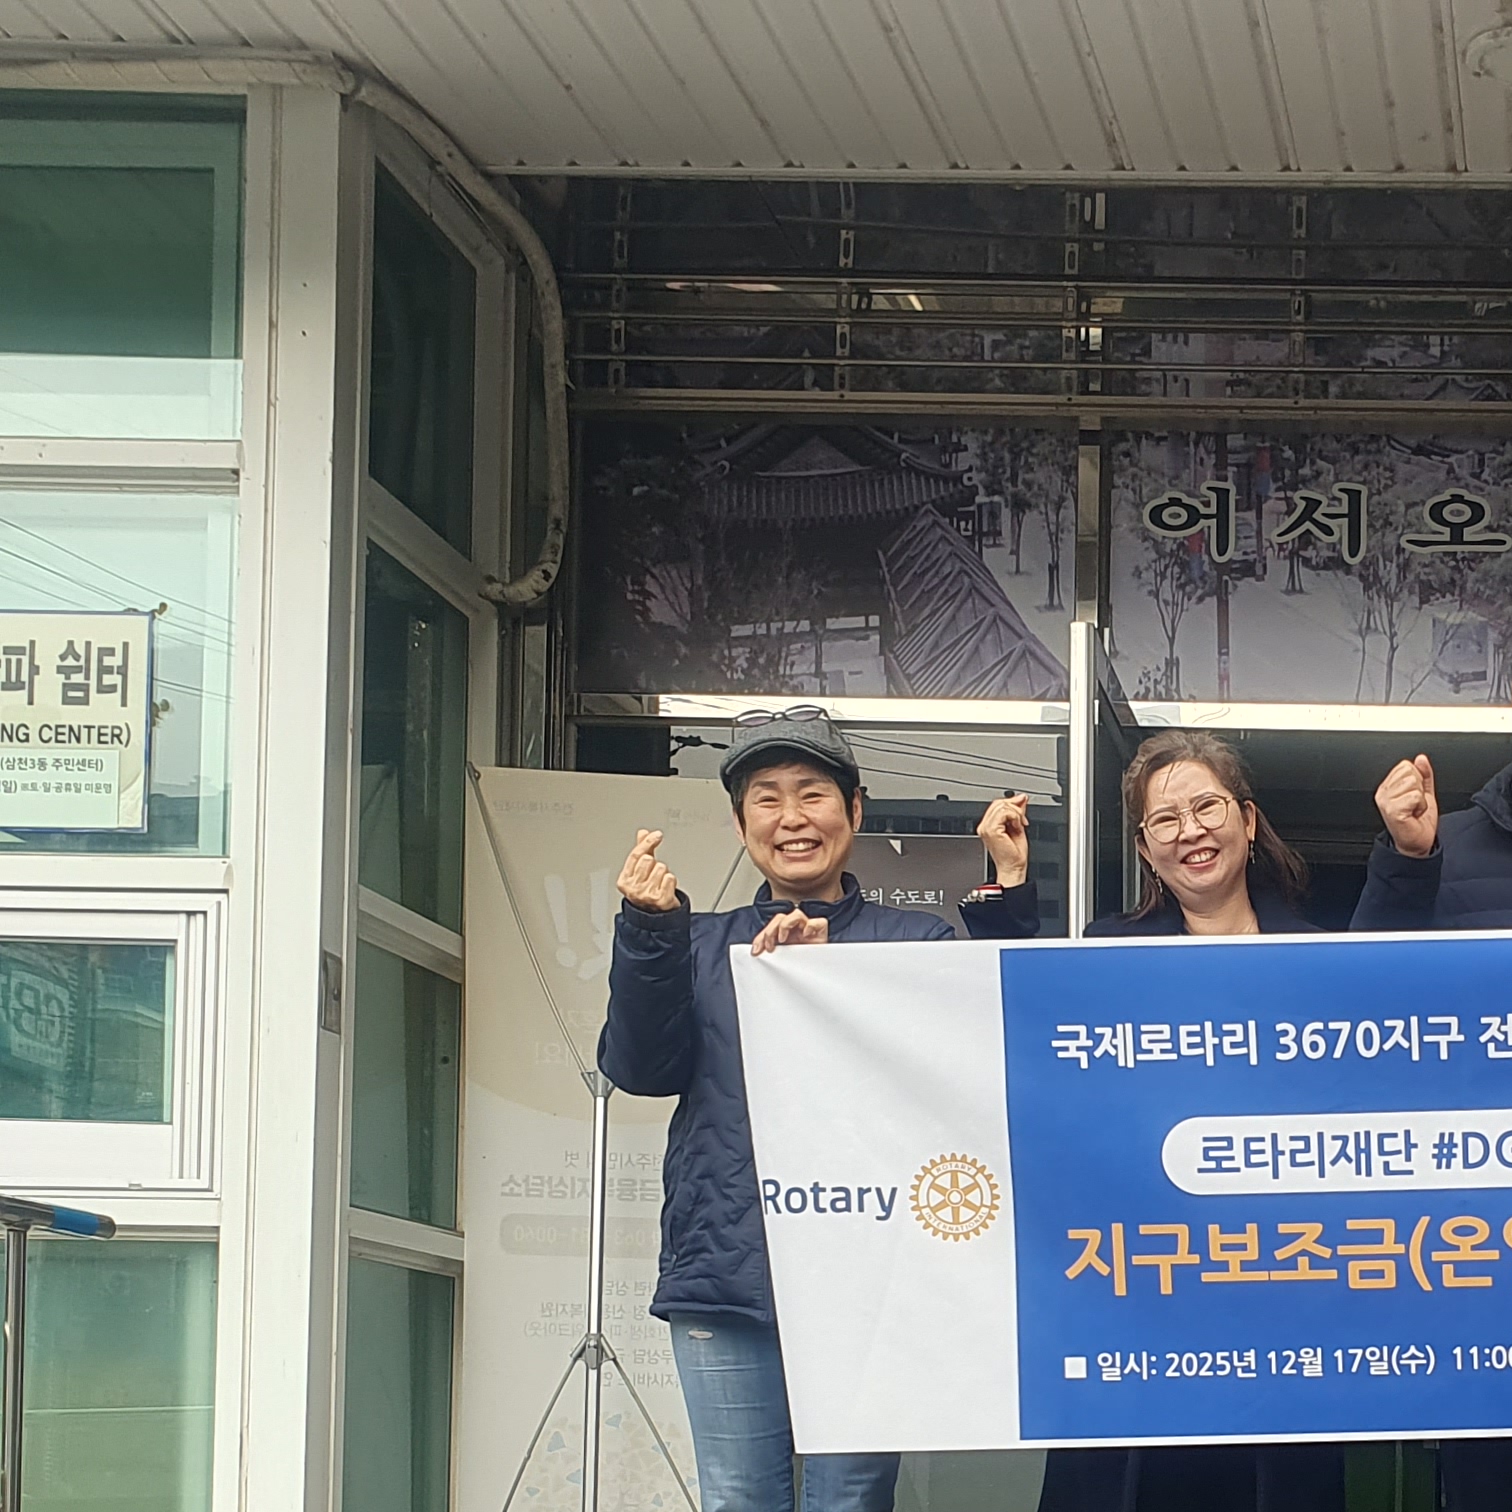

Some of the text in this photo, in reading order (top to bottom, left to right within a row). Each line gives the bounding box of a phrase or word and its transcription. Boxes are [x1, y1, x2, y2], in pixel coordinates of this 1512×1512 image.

[0, 639, 129, 708] 파 쉼터
[38, 722, 131, 748] CENTER)
[0, 756, 104, 773] (삼천3동 주민센터)
[0, 780, 18, 794] 일)
[84, 782, 112, 795] 미운영
[889, 888, 944, 906] 수도로!
[1051, 1019, 1258, 1069] 국제로타리
[1274, 1015, 1465, 1062] 3670지구
[1197, 1129, 1419, 1180] 로타리재단
[761, 1178, 898, 1221] Rotary
[1096, 1350, 1158, 1381] 일시:
[1164, 1348, 1257, 1379] 2025년
[1266, 1346, 1324, 1377] 12월
[1334, 1343, 1436, 1376] 17일(수)
